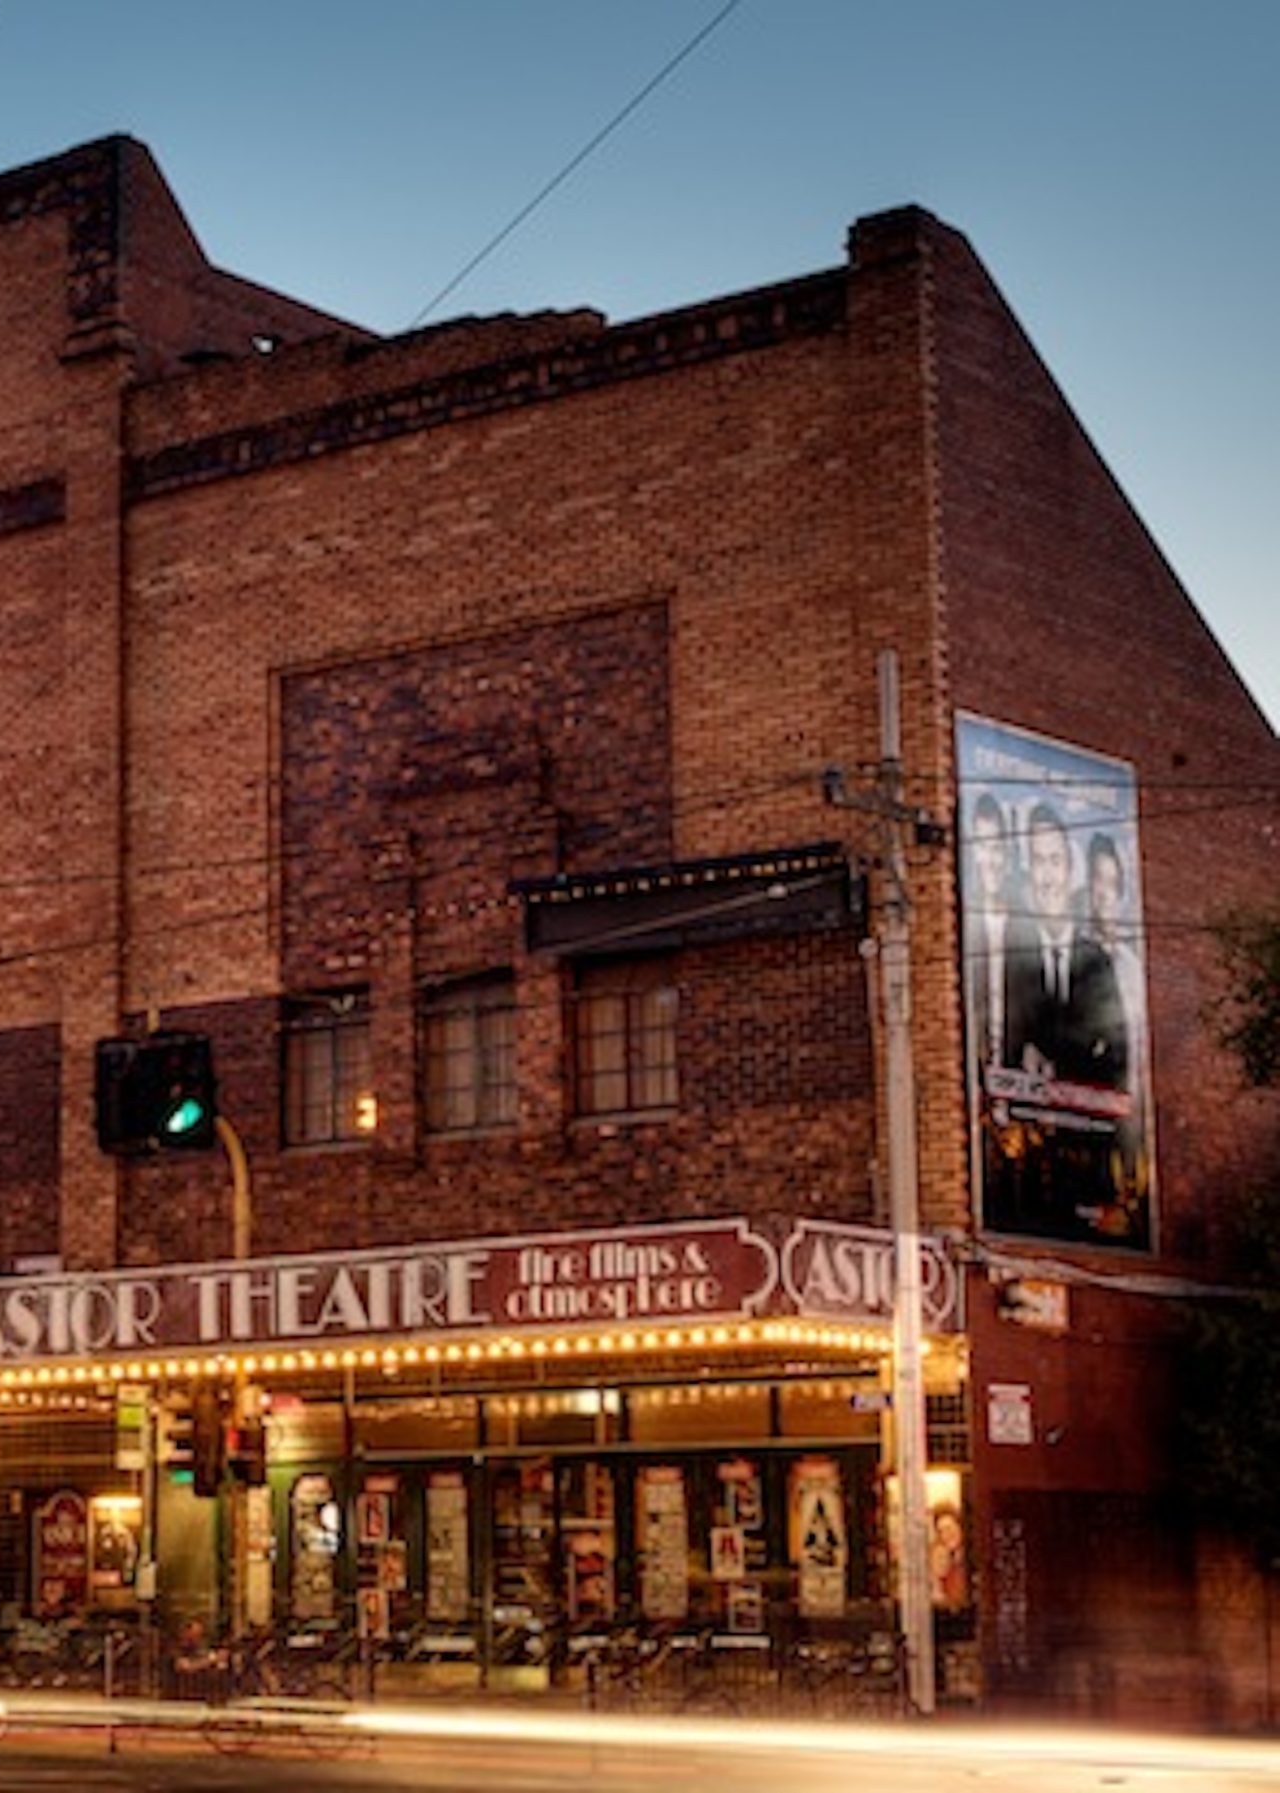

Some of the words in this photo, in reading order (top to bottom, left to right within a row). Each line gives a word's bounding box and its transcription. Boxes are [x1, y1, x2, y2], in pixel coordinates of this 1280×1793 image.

[588, 1241, 678, 1280] films
[680, 1240, 710, 1274] &
[189, 1251, 492, 1342] THEATRE
[505, 1273, 723, 1320] atmosphere
